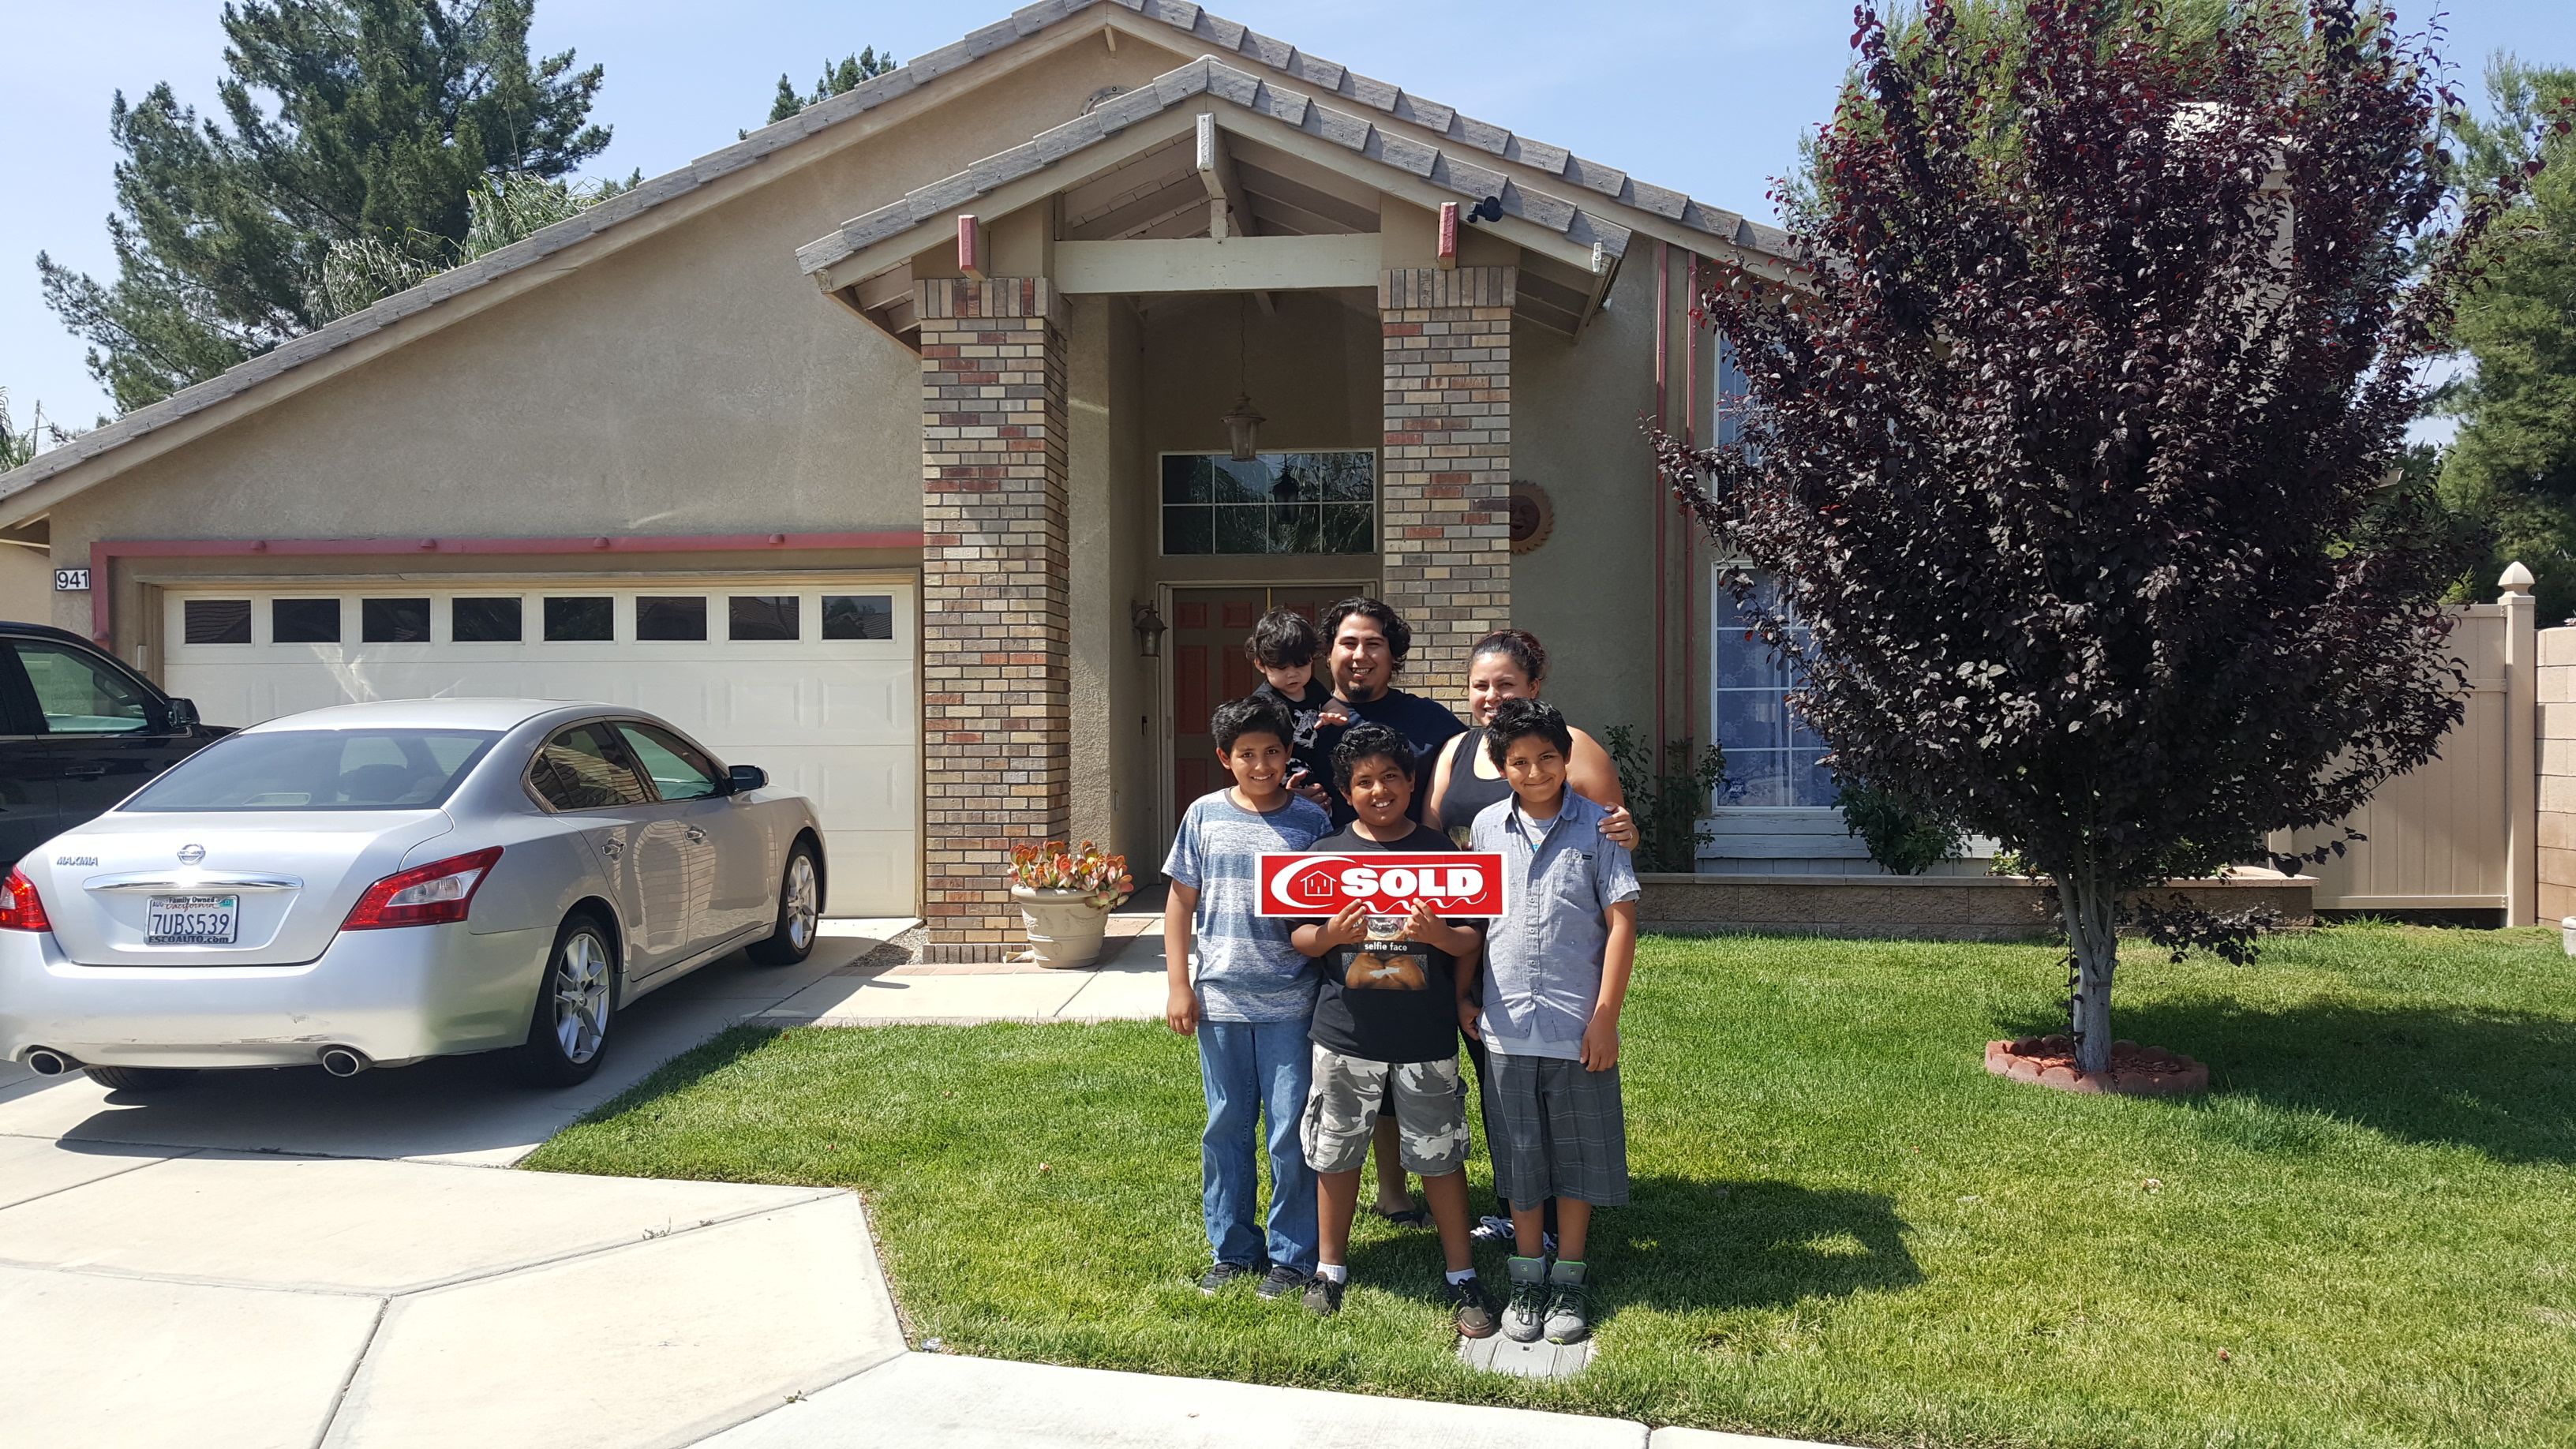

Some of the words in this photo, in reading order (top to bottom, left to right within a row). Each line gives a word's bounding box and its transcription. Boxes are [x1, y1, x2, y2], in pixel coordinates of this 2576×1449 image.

[57, 571, 88, 589] 941
[56, 856, 99, 867] MAXIMA
[1340, 867, 1485, 898] SOLD
[152, 913, 230, 935] 7UBS539
[1364, 942, 1387, 950] selfie
[1389, 942, 1408, 952] face
